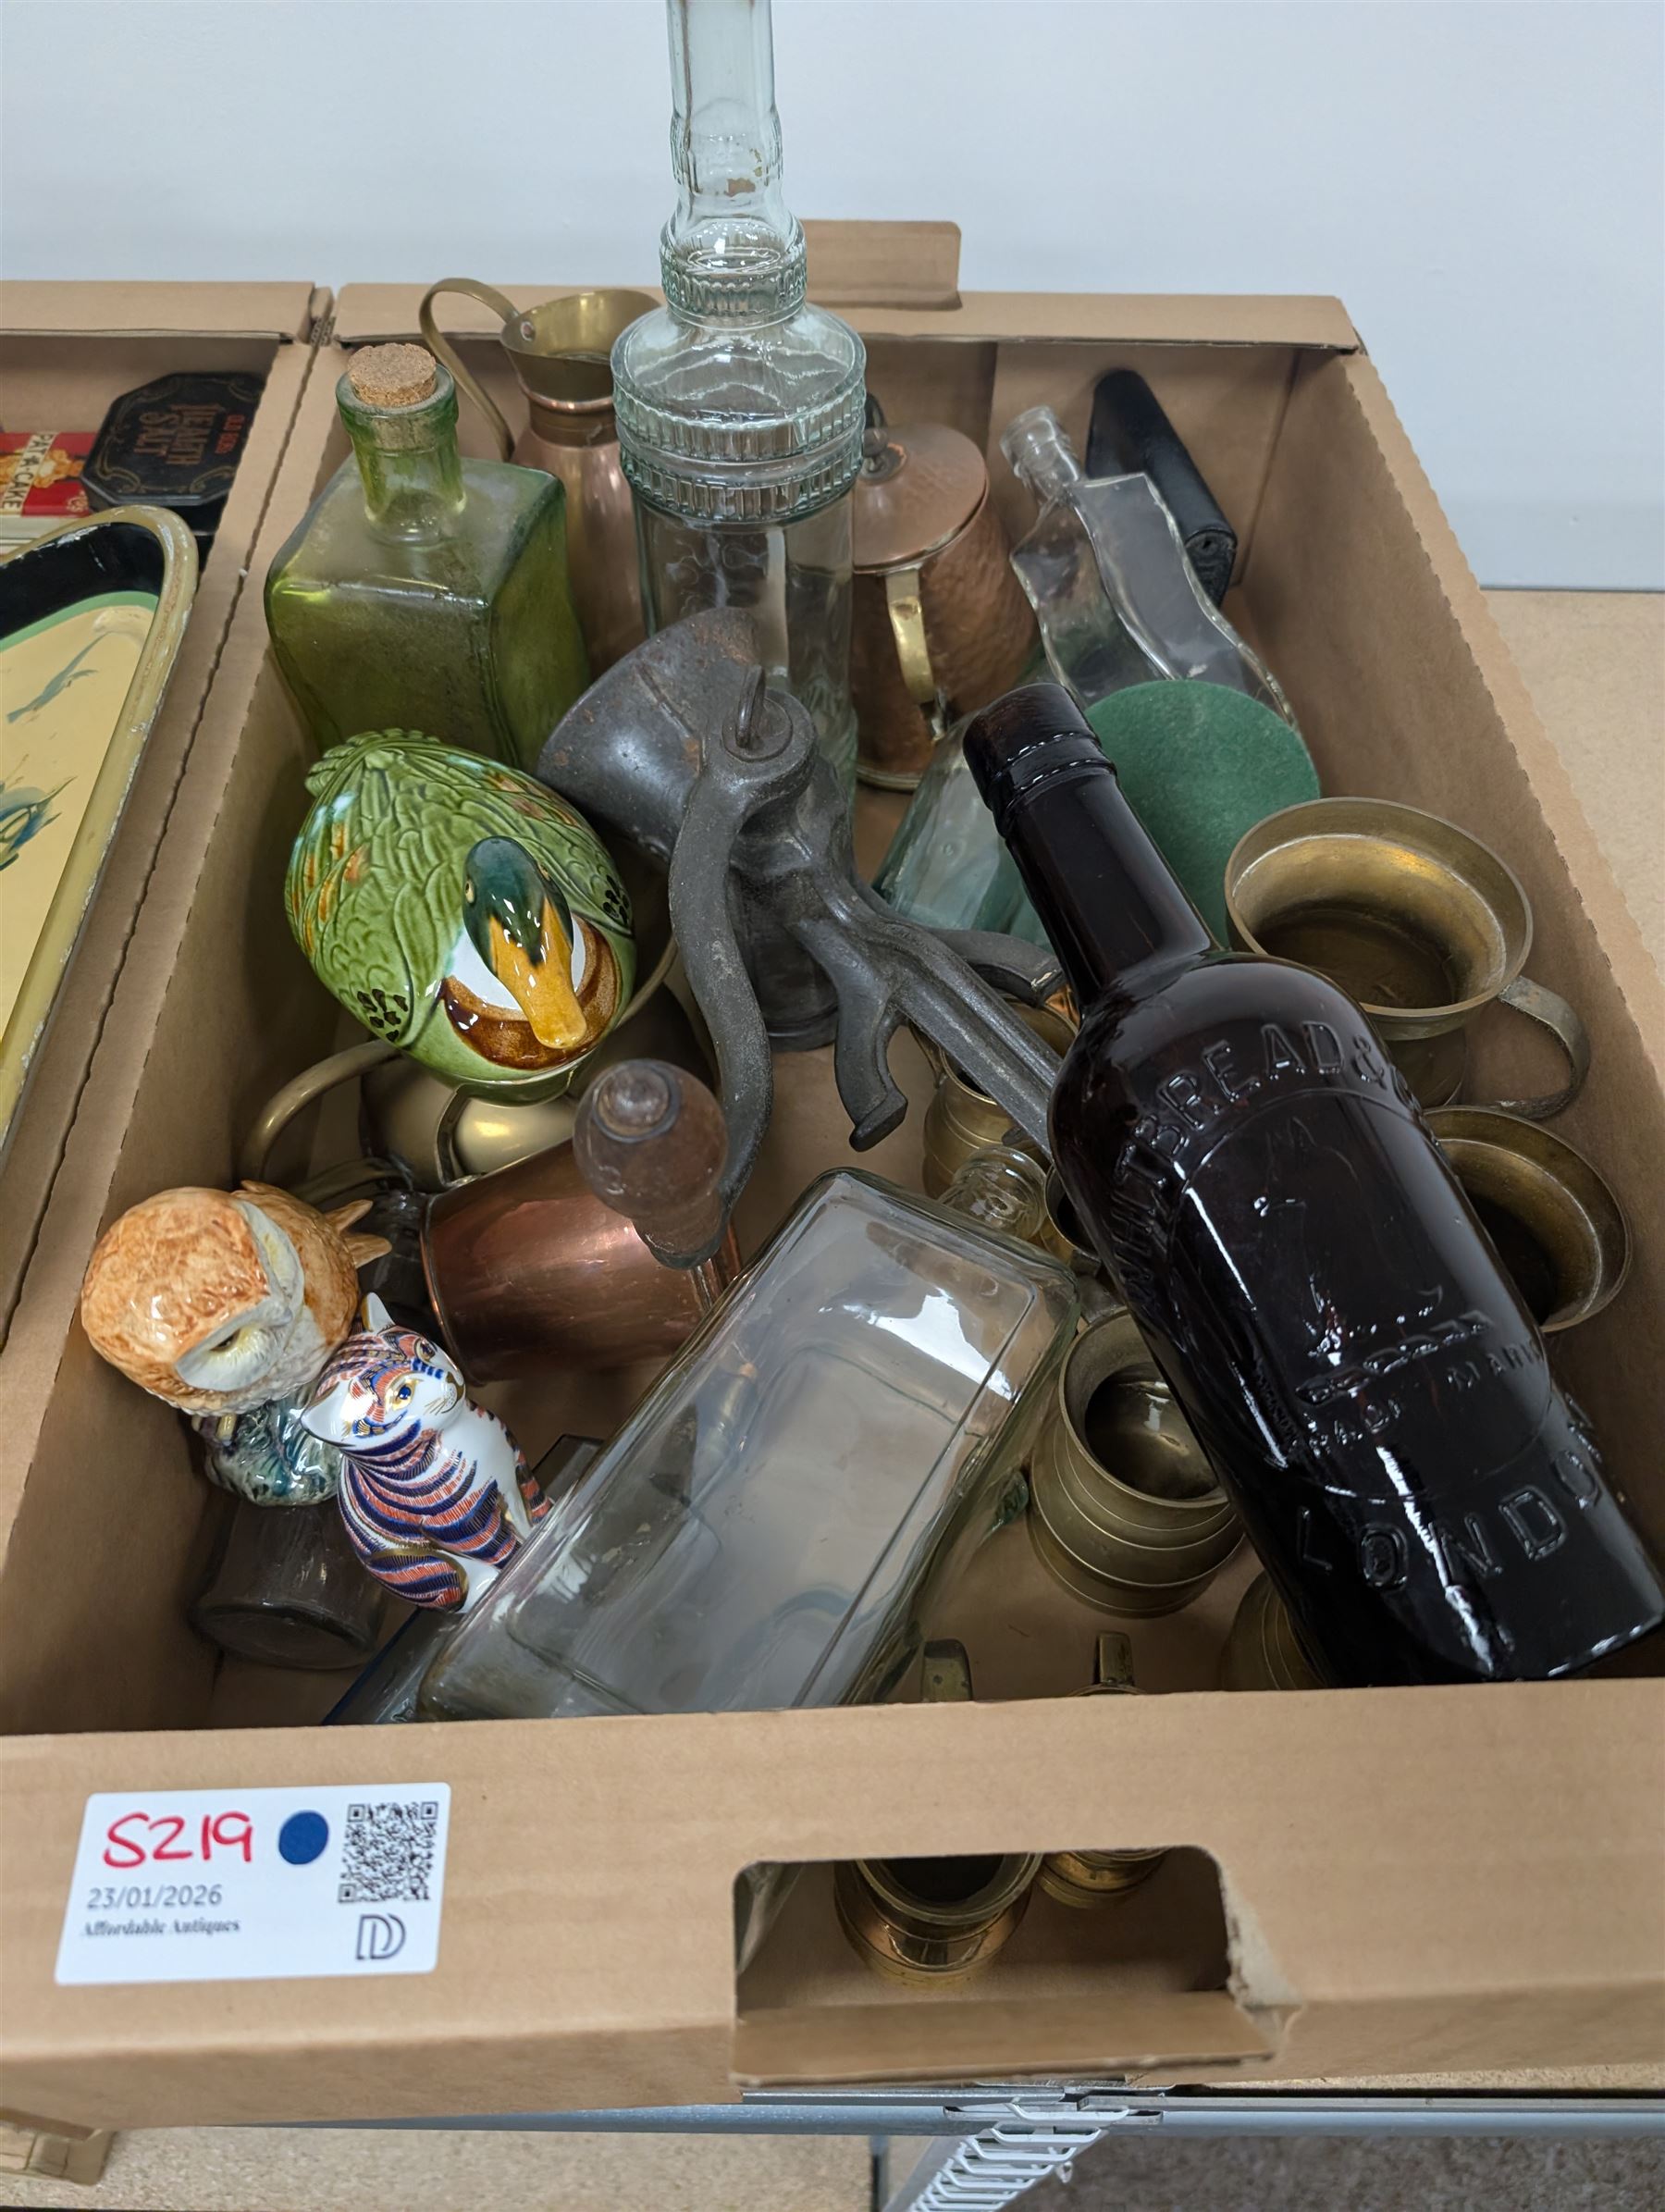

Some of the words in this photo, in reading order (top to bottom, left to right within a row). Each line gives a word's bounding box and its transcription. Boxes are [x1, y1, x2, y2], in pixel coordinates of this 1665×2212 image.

[103, 1811, 253, 1869] S219
[87, 1885, 223, 1909] 23/01/2026
[82, 1919, 166, 1938] Affordable
[173, 1917, 240, 1935] Antiques
